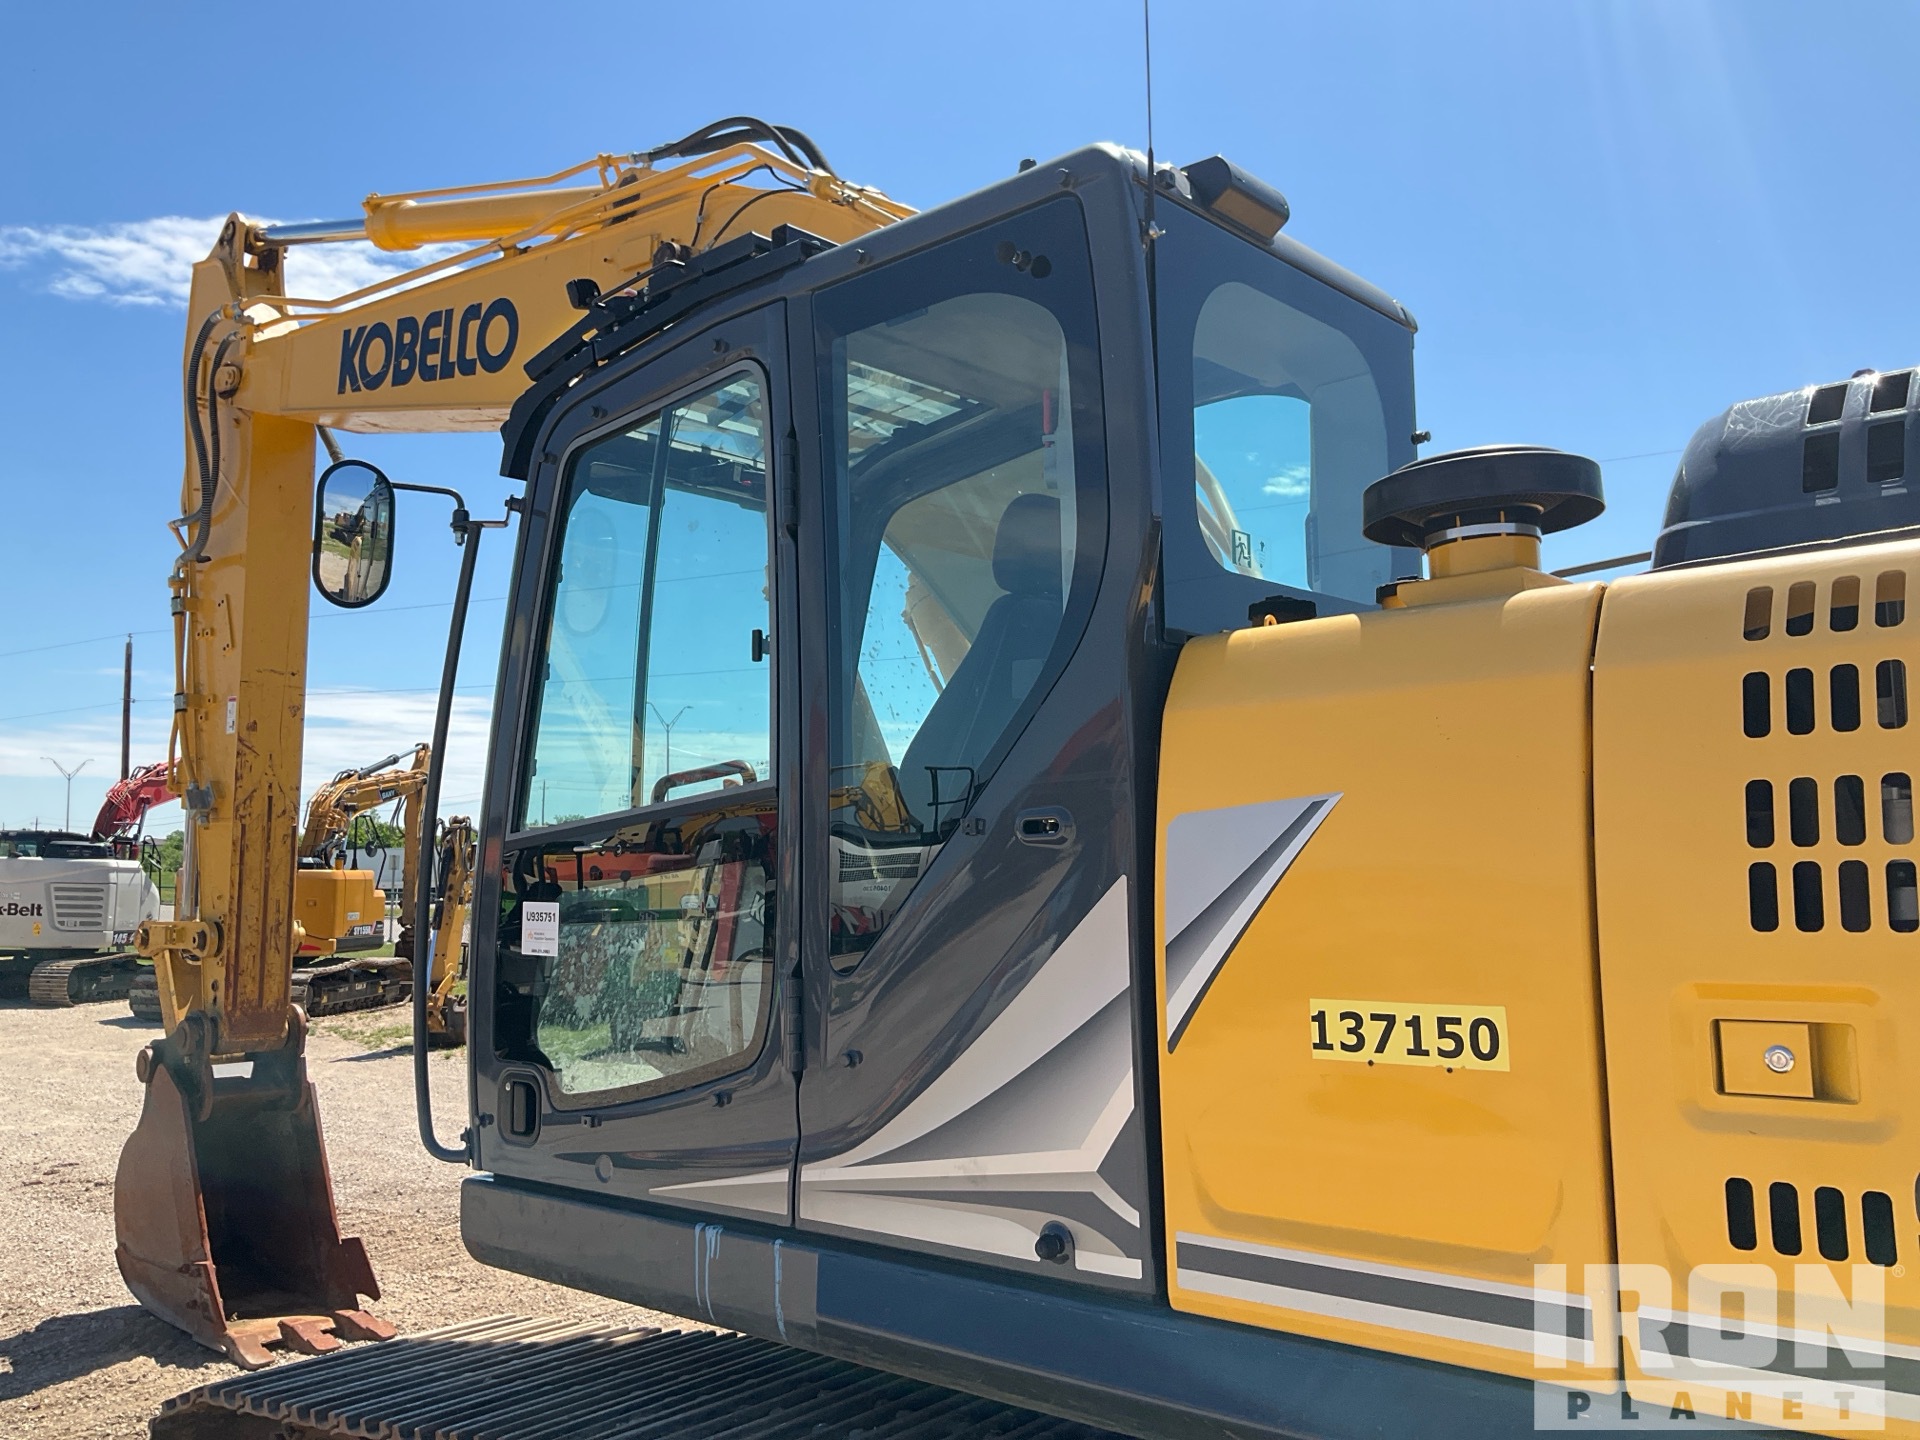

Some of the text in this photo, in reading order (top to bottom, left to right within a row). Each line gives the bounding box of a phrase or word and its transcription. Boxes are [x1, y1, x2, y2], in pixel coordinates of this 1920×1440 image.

[337, 297, 519, 395] KOBELCO
[526, 911, 556, 923] U935751
[112, 932, 129, 945] 145
[1311, 1010, 1500, 1062] 137150
